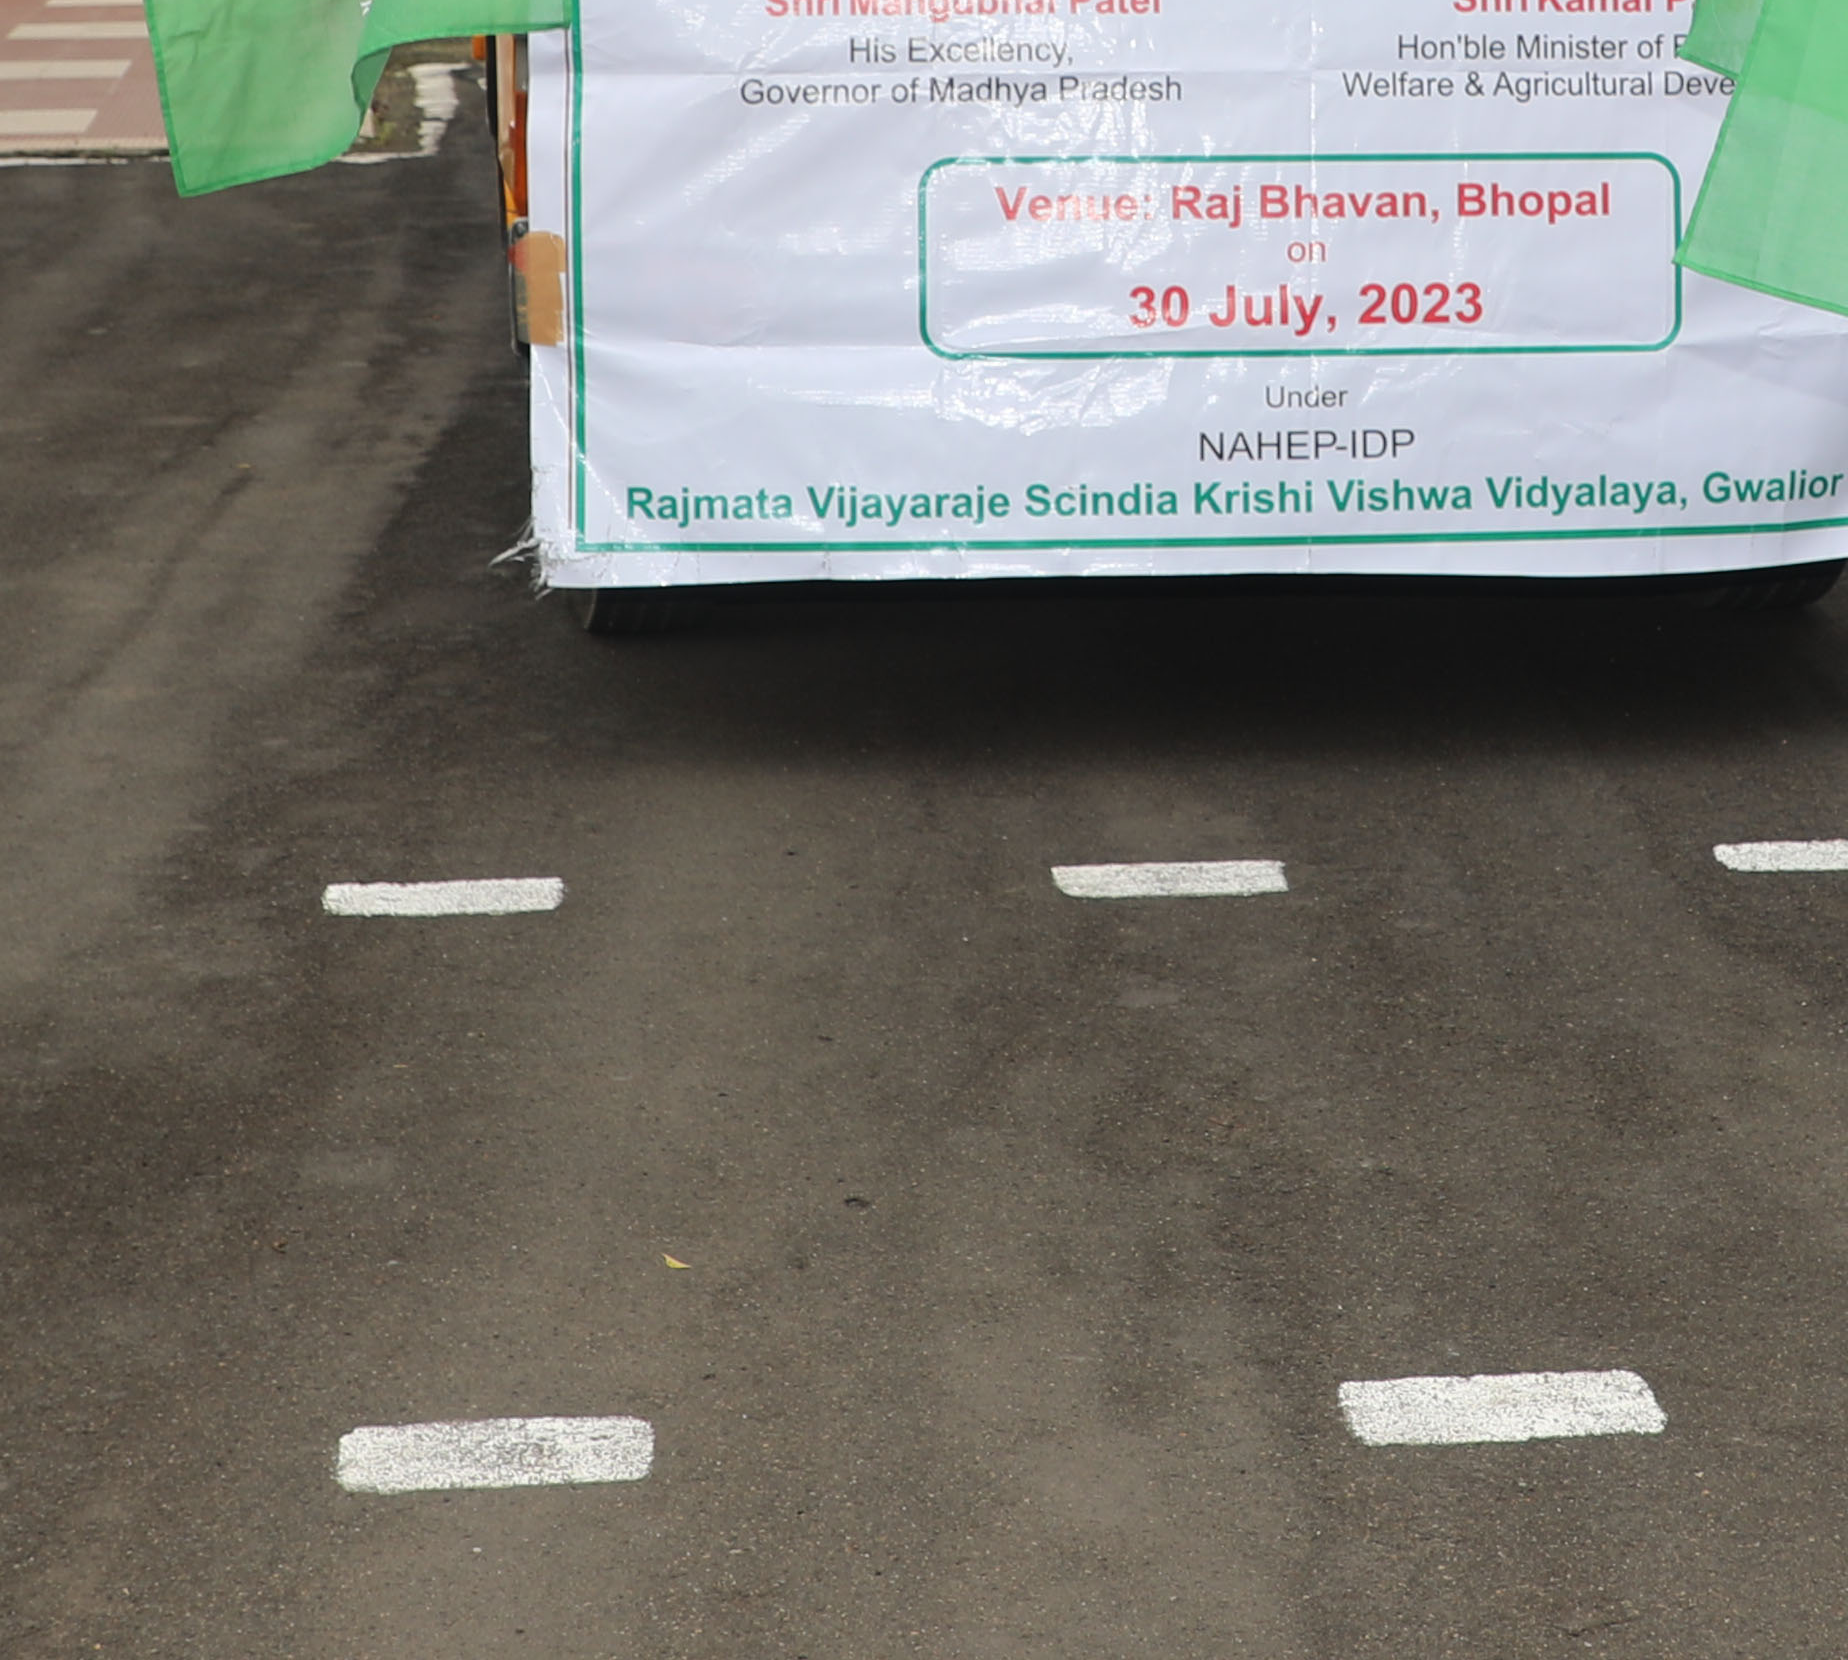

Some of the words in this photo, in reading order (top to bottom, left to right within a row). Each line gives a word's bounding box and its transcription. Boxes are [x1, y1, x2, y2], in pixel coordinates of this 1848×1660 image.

[849, 37, 897, 64] His
[907, 35, 1074, 69] Excellency,
[1398, 34, 1506, 60] Hon'ble
[1516, 33, 1628, 60] Minister
[1636, 33, 1665, 60] of
[739, 78, 882, 106] Governor
[891, 76, 920, 104] of
[929, 75, 1047, 107] Madhya
[1058, 74, 1182, 102] Pradesh
[1342, 70, 1454, 98] Welfare
[1464, 70, 1485, 97] &
[1492, 70, 1653, 104] Agricultural
[994, 187, 1153, 221] Venue:
[1172, 185, 1241, 229] Raj
[1260, 184, 1439, 223] Bhavan,
[1457, 182, 1610, 225] Bhopal
[1286, 241, 1326, 263] on
[1129, 285, 1189, 327] 30
[1209, 285, 1338, 336] July,
[1358, 282, 1483, 325] 2023
[1265, 385, 1349, 409] Under
[1199, 428, 1415, 461] NAHEP-IDP
[627, 486, 792, 529] Rajmata
[807, 485, 1011, 528] Vijayaraje
[1025, 483, 1178, 517] Scindia
[1194, 480, 1313, 514] Krishi
[1327, 478, 1472, 512] Vishwa
[1485, 474, 1687, 516] Vidyalaya,
[1703, 470, 1844, 504] Gwalior
